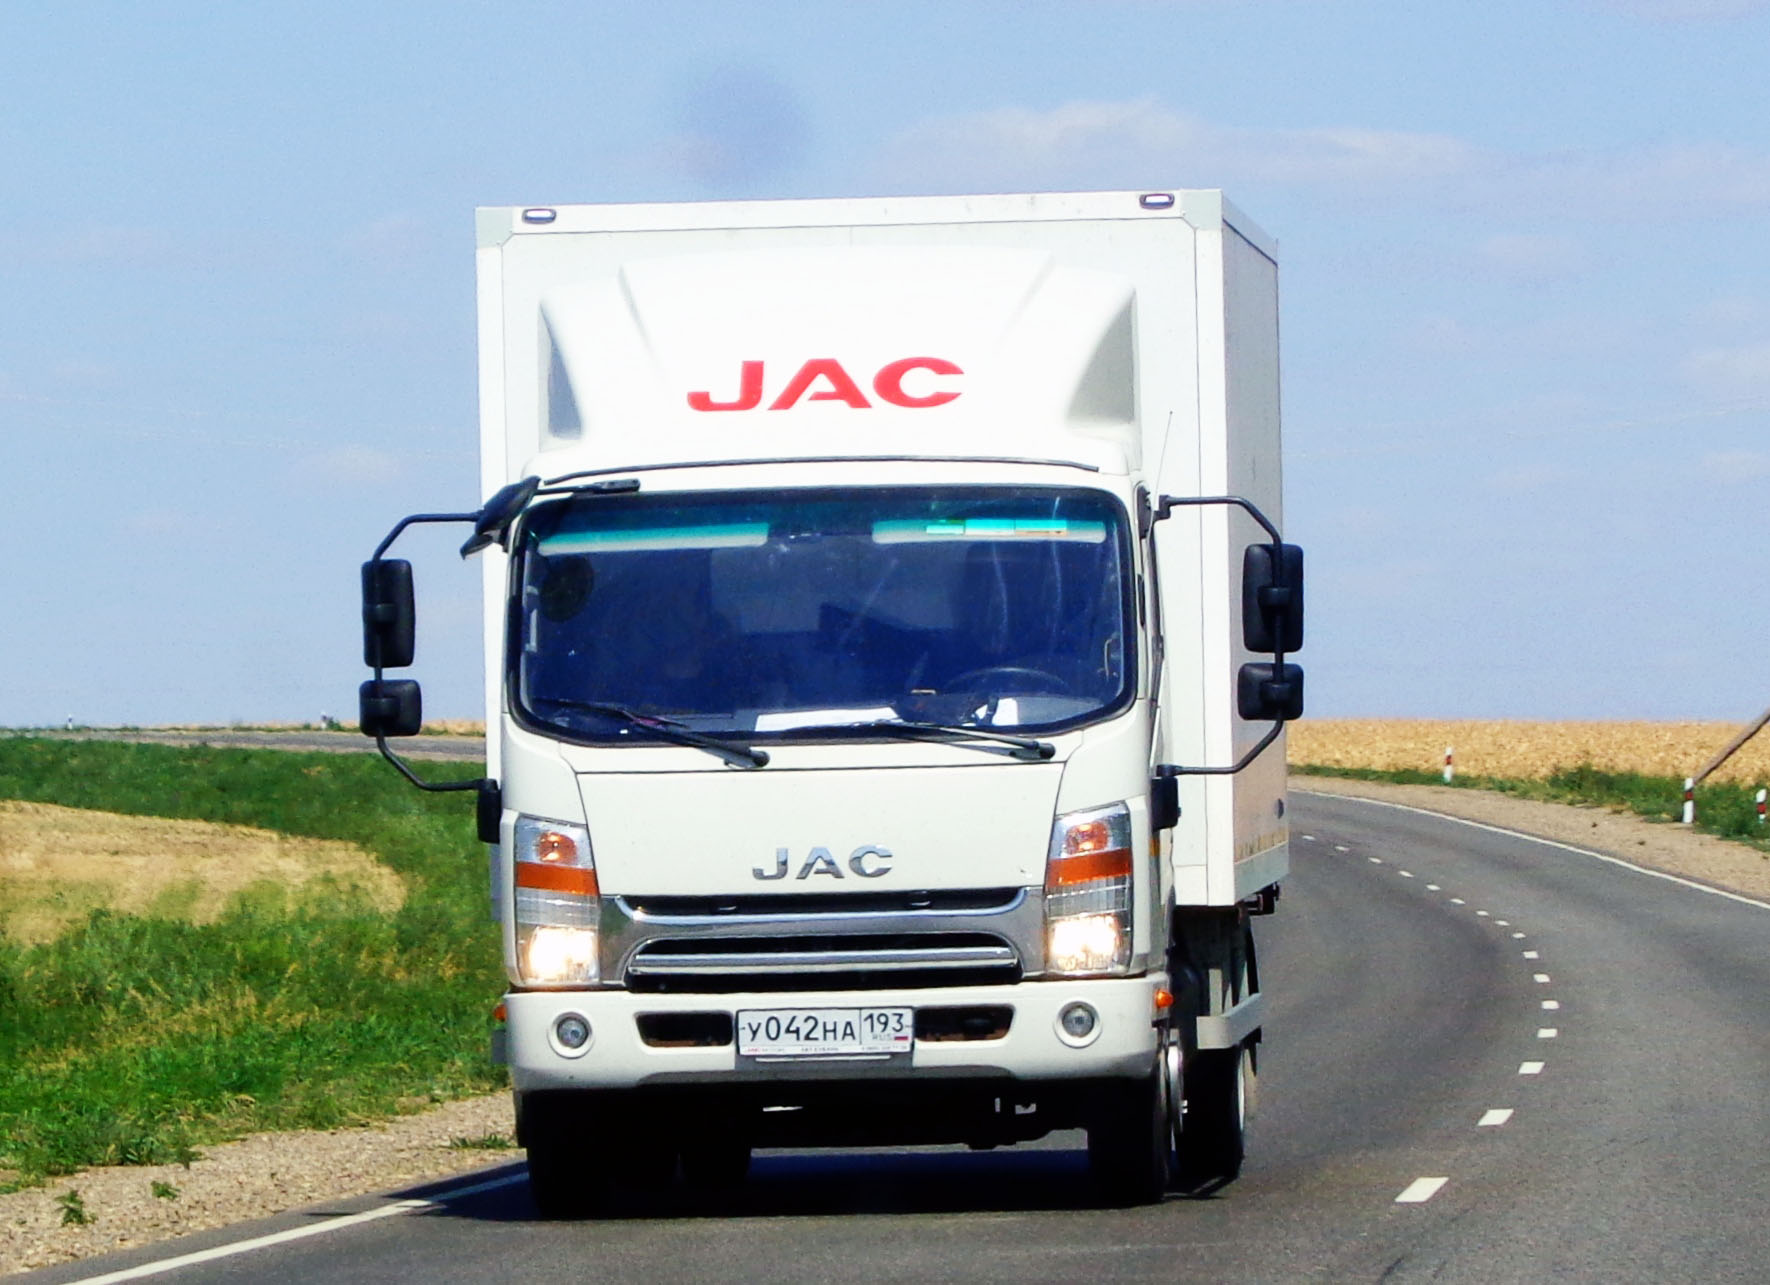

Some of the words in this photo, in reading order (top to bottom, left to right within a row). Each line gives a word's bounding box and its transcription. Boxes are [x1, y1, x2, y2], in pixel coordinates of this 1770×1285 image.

[687, 356, 965, 412] JAC
[752, 844, 893, 880] JAC
[864, 1013, 904, 1033] 193
